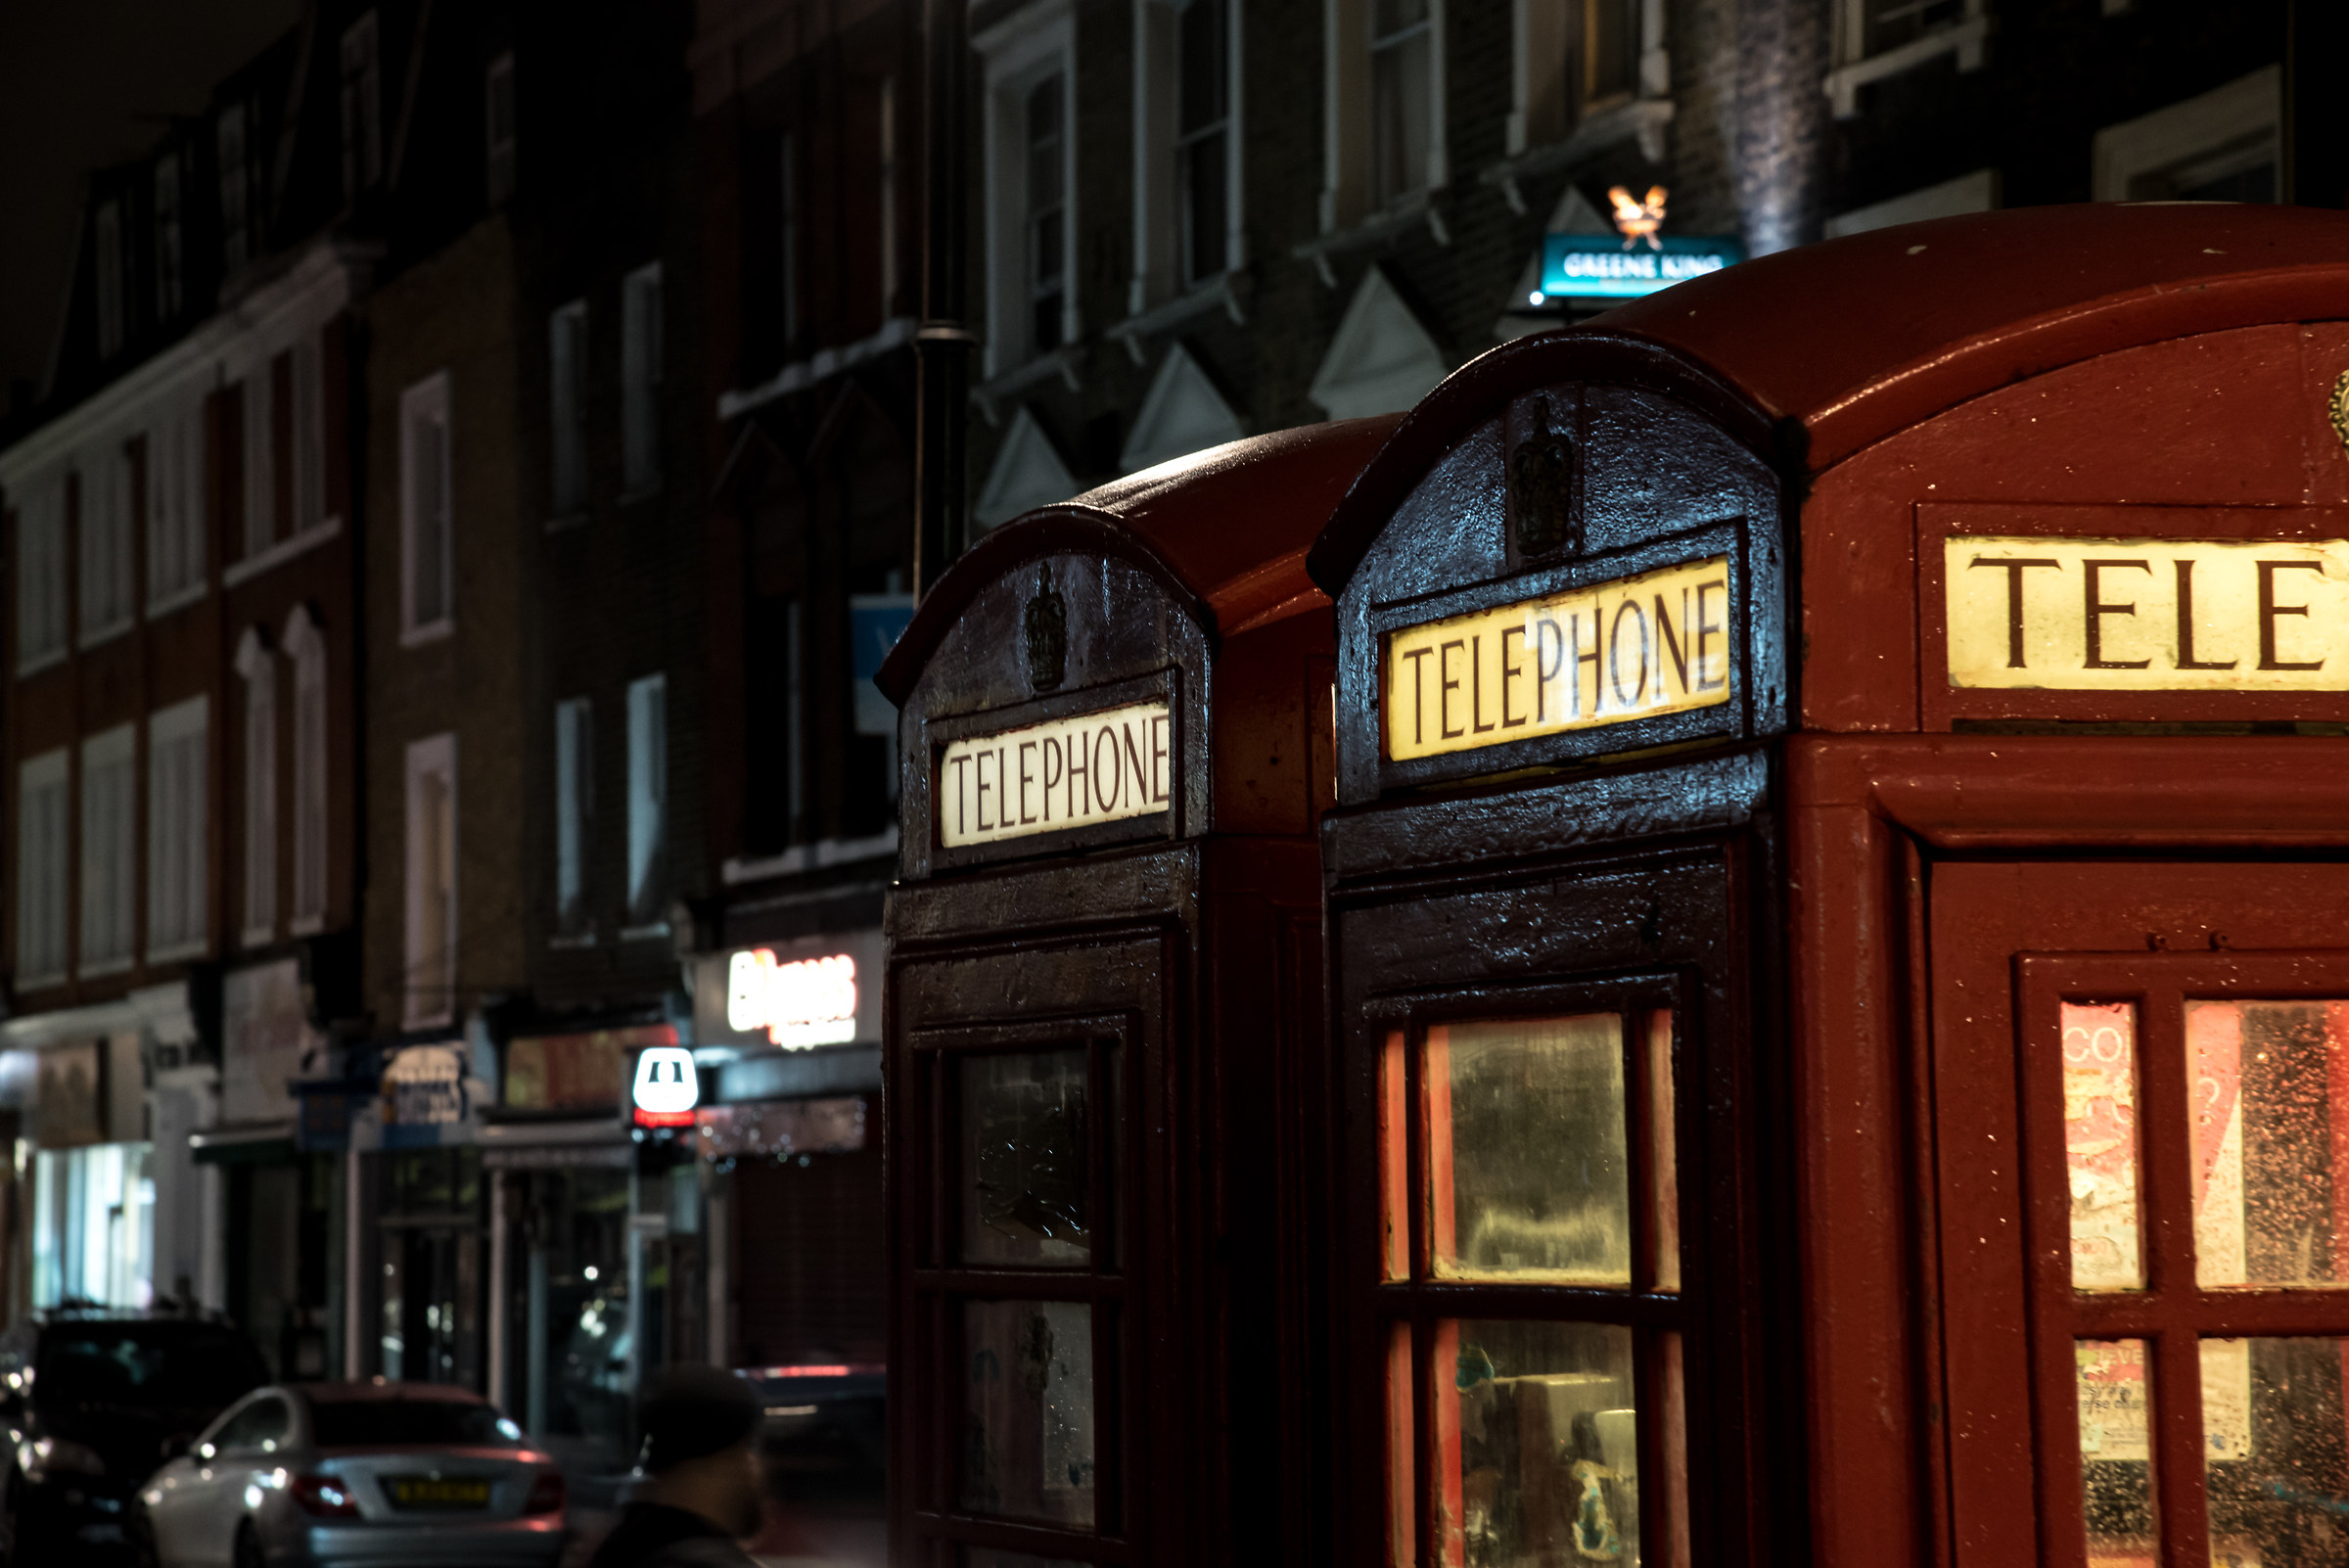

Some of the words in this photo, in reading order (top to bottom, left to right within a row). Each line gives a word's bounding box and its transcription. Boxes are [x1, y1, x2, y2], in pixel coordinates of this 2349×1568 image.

[1563, 252, 1657, 279] GREENE
[1402, 577, 1727, 747] TELEPHONE
[1966, 557, 2327, 672] TELE
[949, 714, 1170, 836] TELEPHONE
